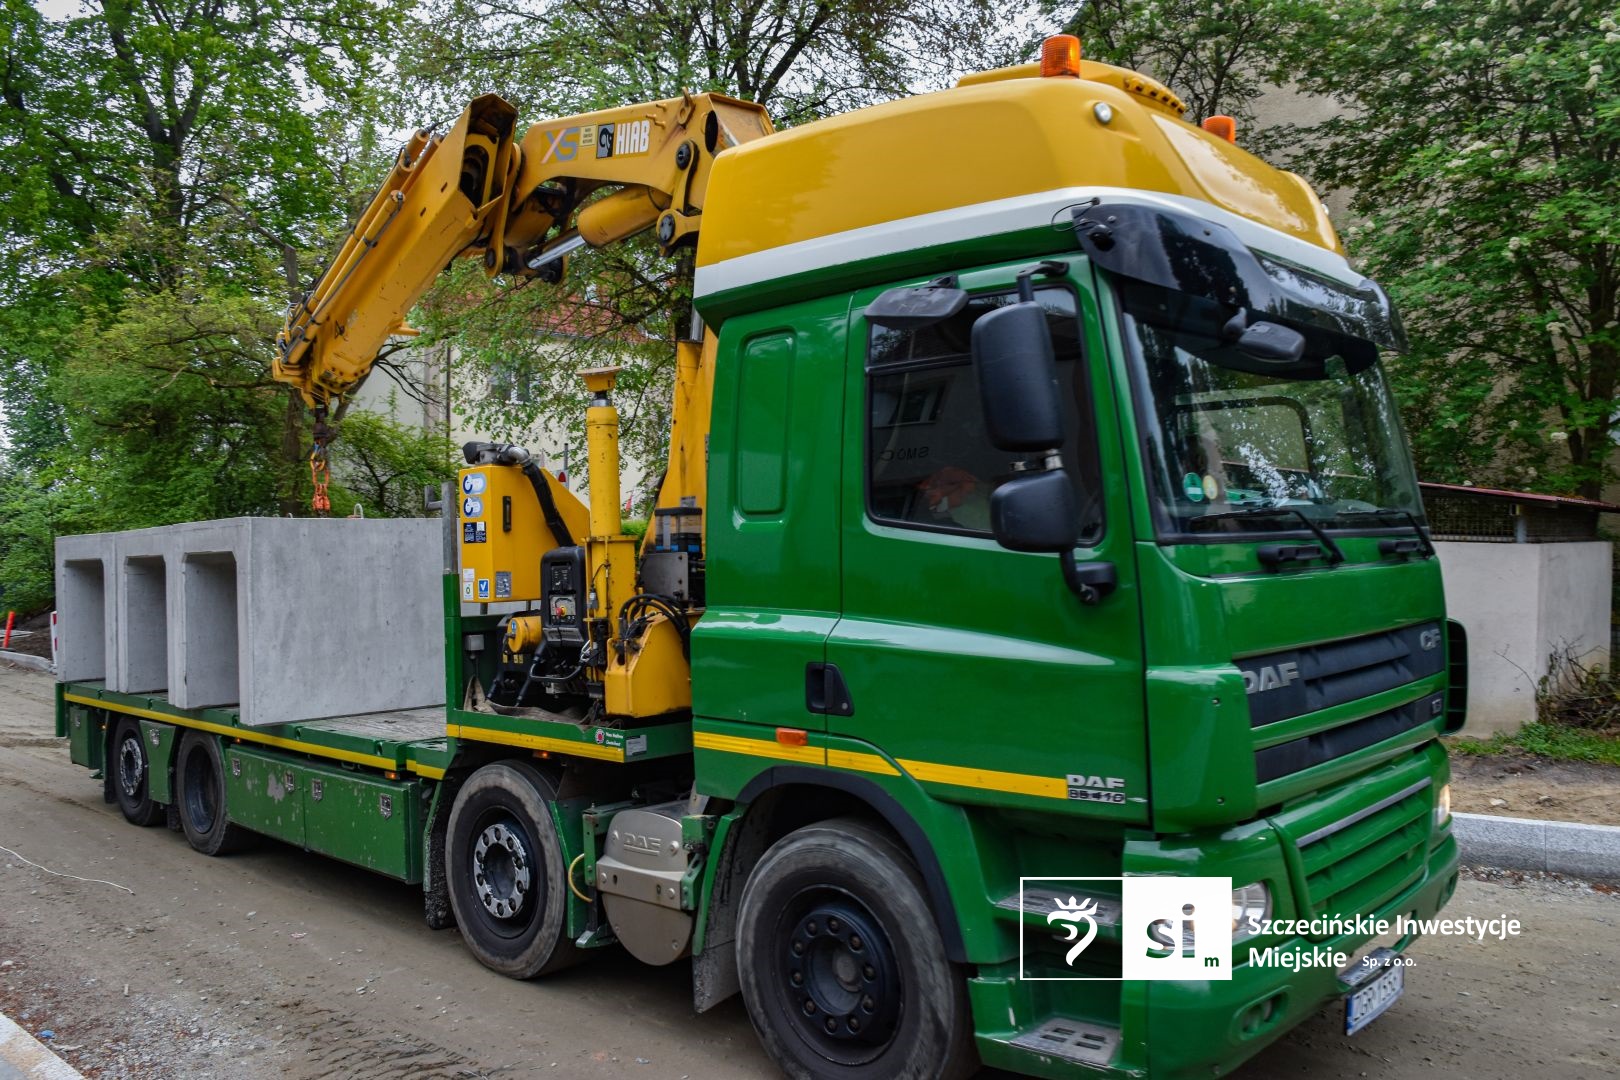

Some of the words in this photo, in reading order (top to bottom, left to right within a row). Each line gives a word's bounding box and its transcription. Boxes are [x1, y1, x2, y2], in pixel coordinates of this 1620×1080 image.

[541, 127, 579, 164] XS
[615, 120, 650, 155] HIAB
[1420, 628, 1441, 651] CF
[1241, 661, 1299, 694] DAF
[1066, 774, 1126, 789] DAF
[623, 832, 661, 850] DAF
